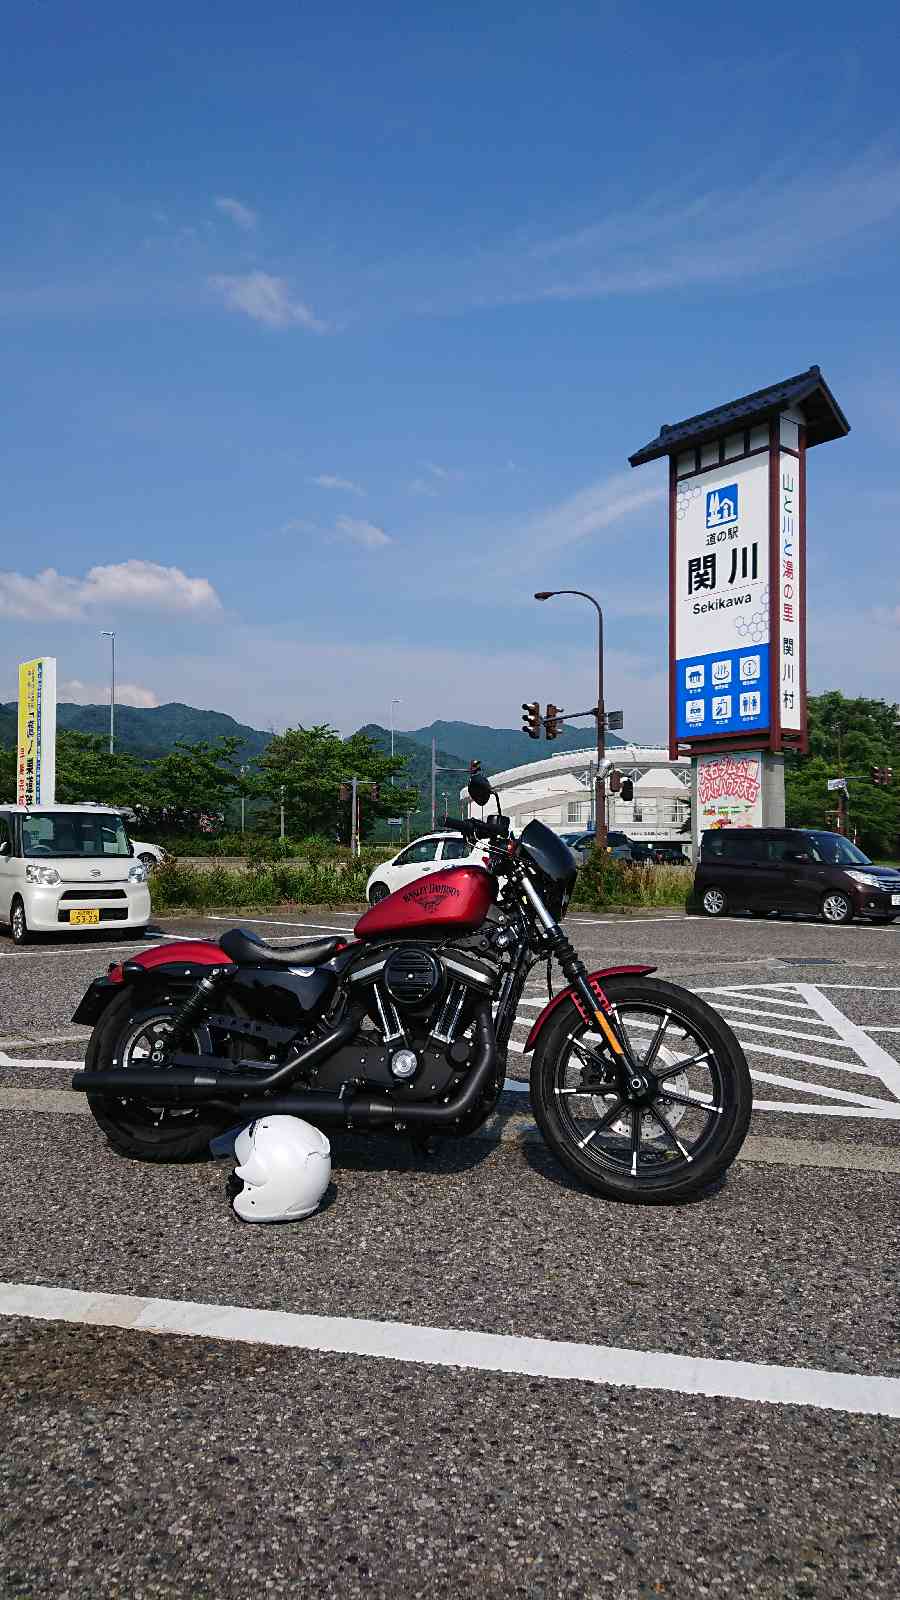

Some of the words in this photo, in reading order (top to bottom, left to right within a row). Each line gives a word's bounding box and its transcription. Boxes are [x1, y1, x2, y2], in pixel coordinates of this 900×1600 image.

[705, 526, 739, 546] 道の駅
[688, 542, 758, 596] 関川
[692, 593, 752, 615] Sekikawa
[782, 637, 794, 710] 関川村
